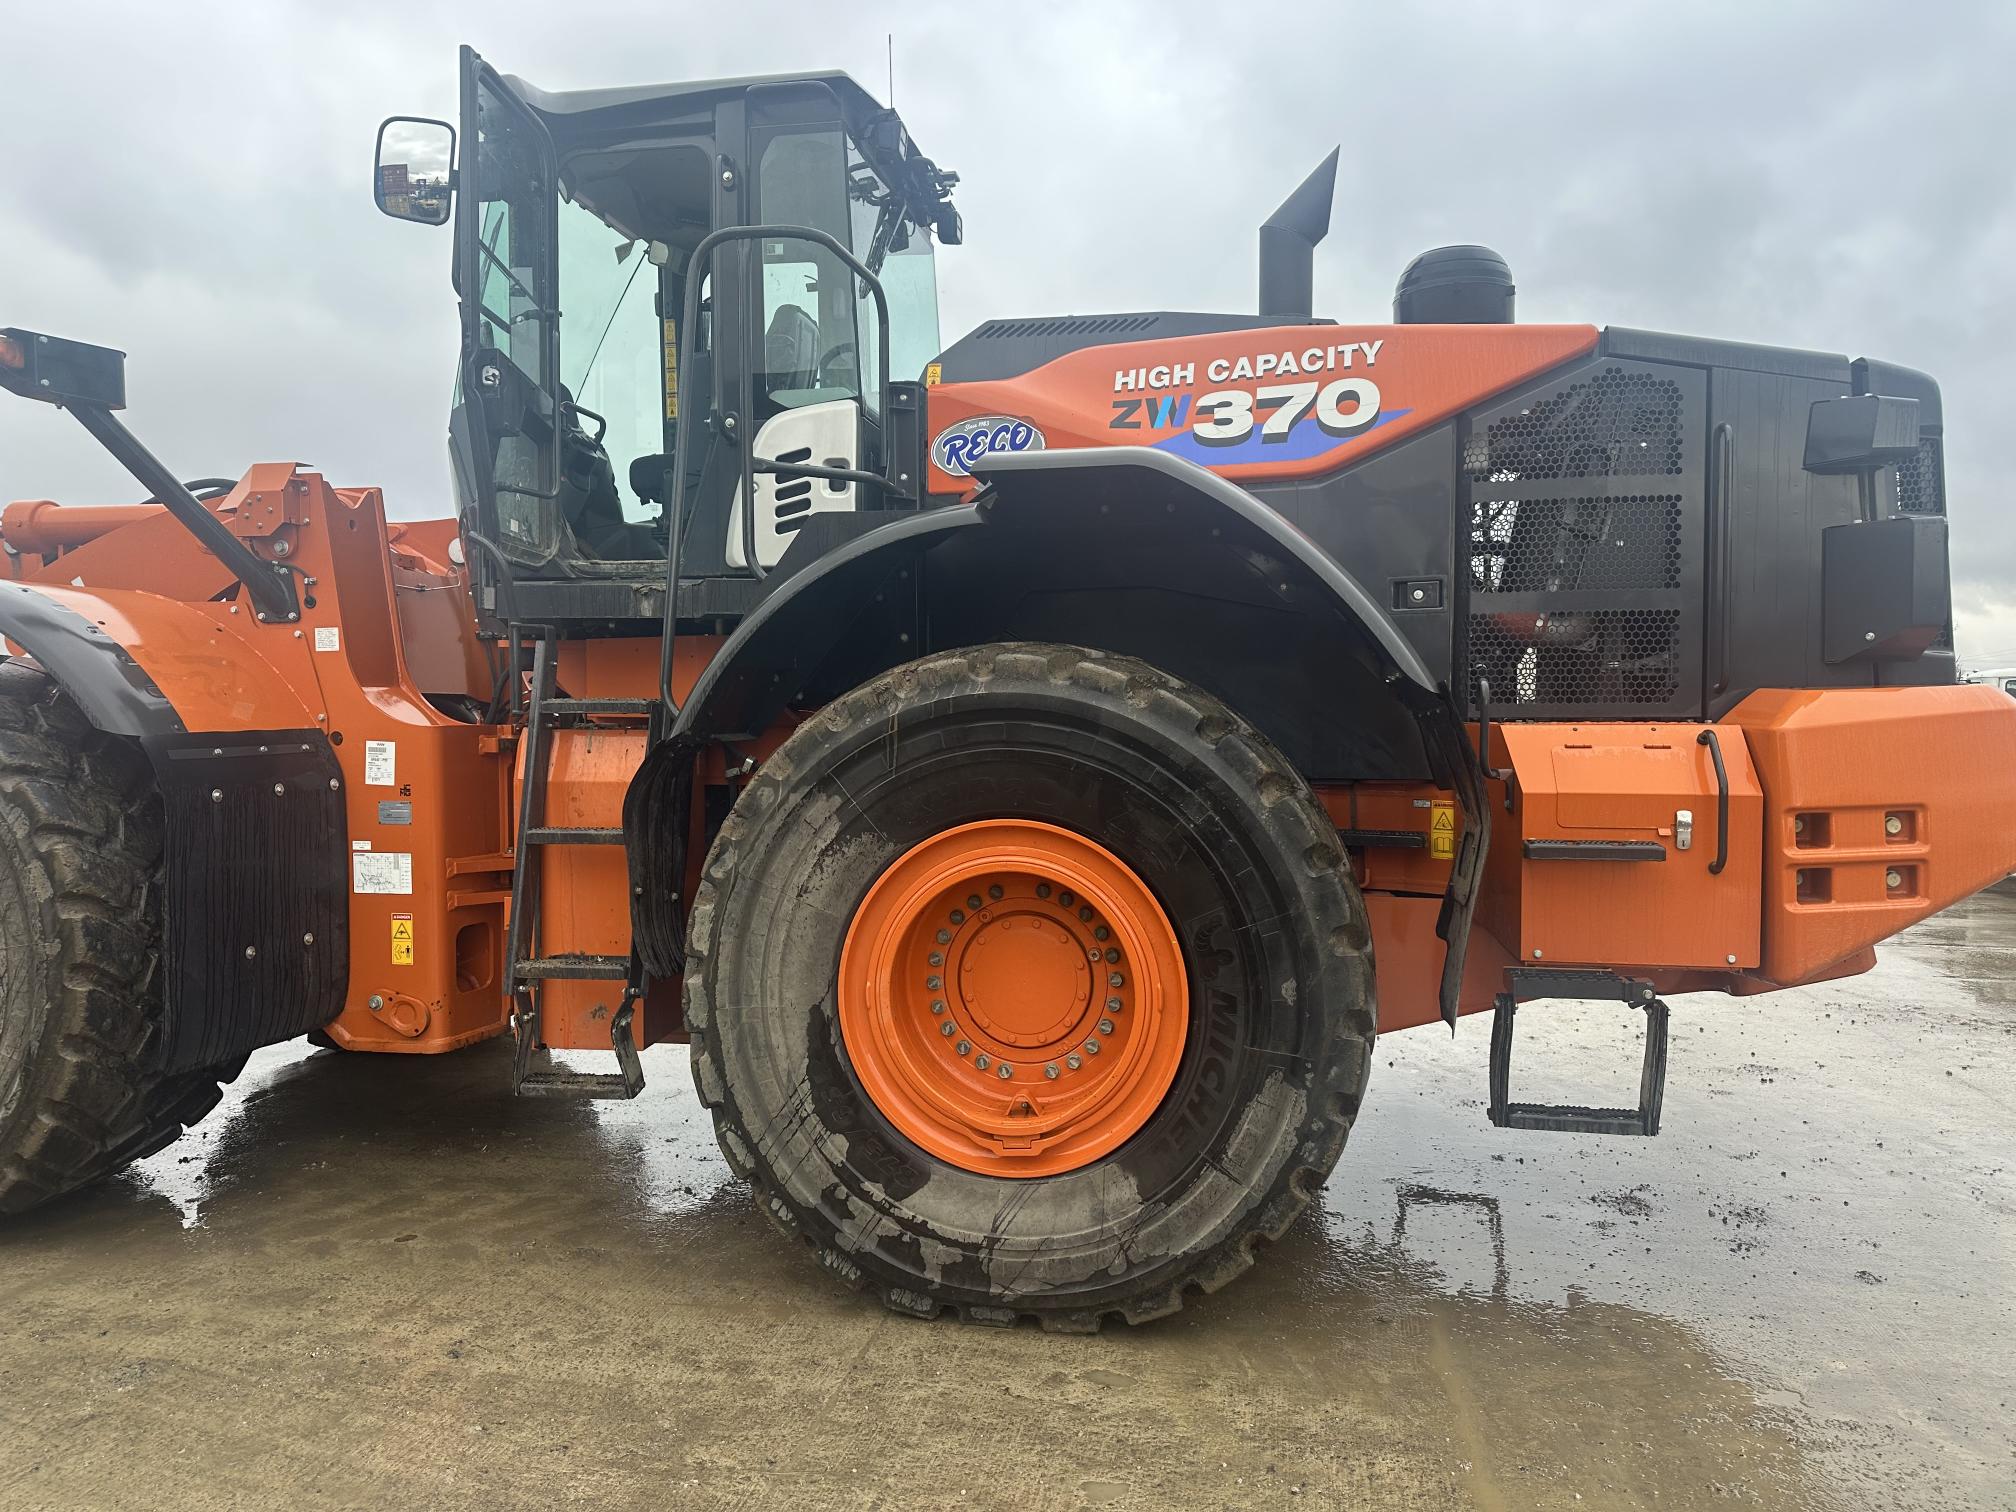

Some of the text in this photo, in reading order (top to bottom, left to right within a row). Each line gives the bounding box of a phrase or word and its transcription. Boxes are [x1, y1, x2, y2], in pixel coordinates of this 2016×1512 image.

[1114, 340, 1384, 393] HIGH CAPACITY
[942, 421, 1034, 474] RECO
